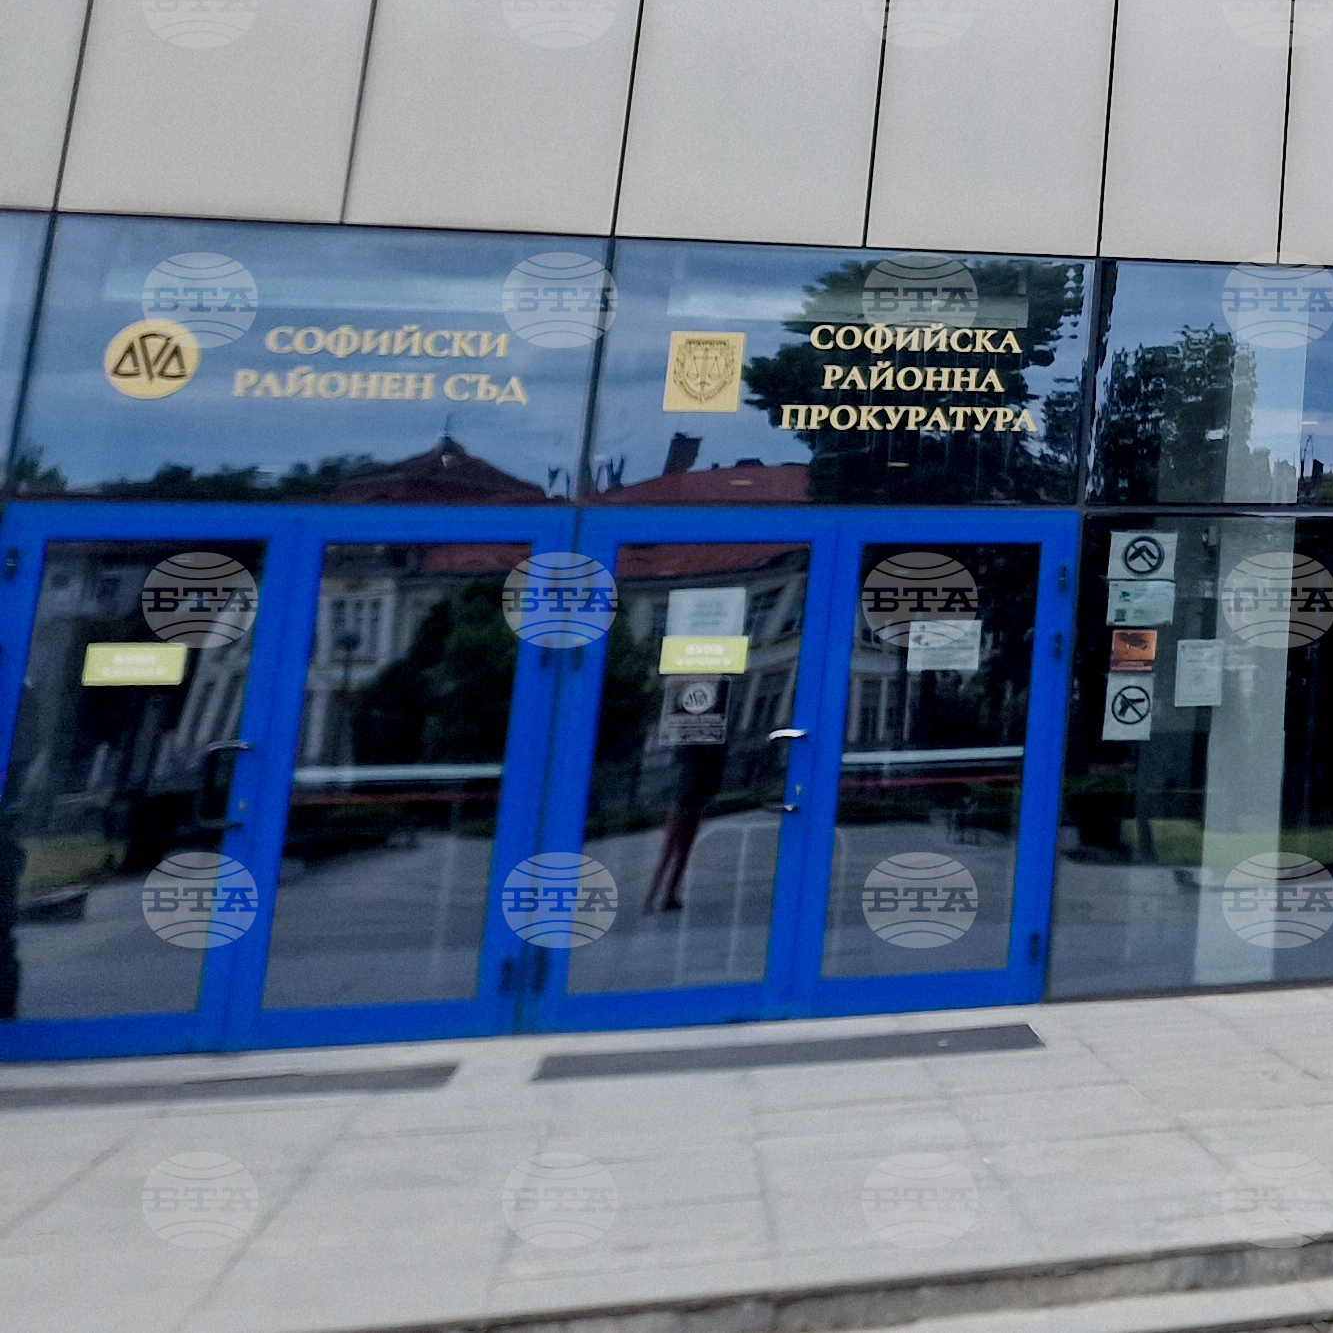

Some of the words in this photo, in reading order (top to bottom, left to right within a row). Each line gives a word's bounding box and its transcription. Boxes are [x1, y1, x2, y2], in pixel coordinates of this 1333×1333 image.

[264, 324, 509, 358] СОФИЙСКИ
[809, 323, 1023, 355] СОФИЙСКА
[232, 366, 436, 400] РАЙОНЕН
[443, 373, 529, 406] СЪД
[821, 361, 1006, 393] РАЙОННА
[779, 404, 1039, 433] ПРОКУРАТУРА
